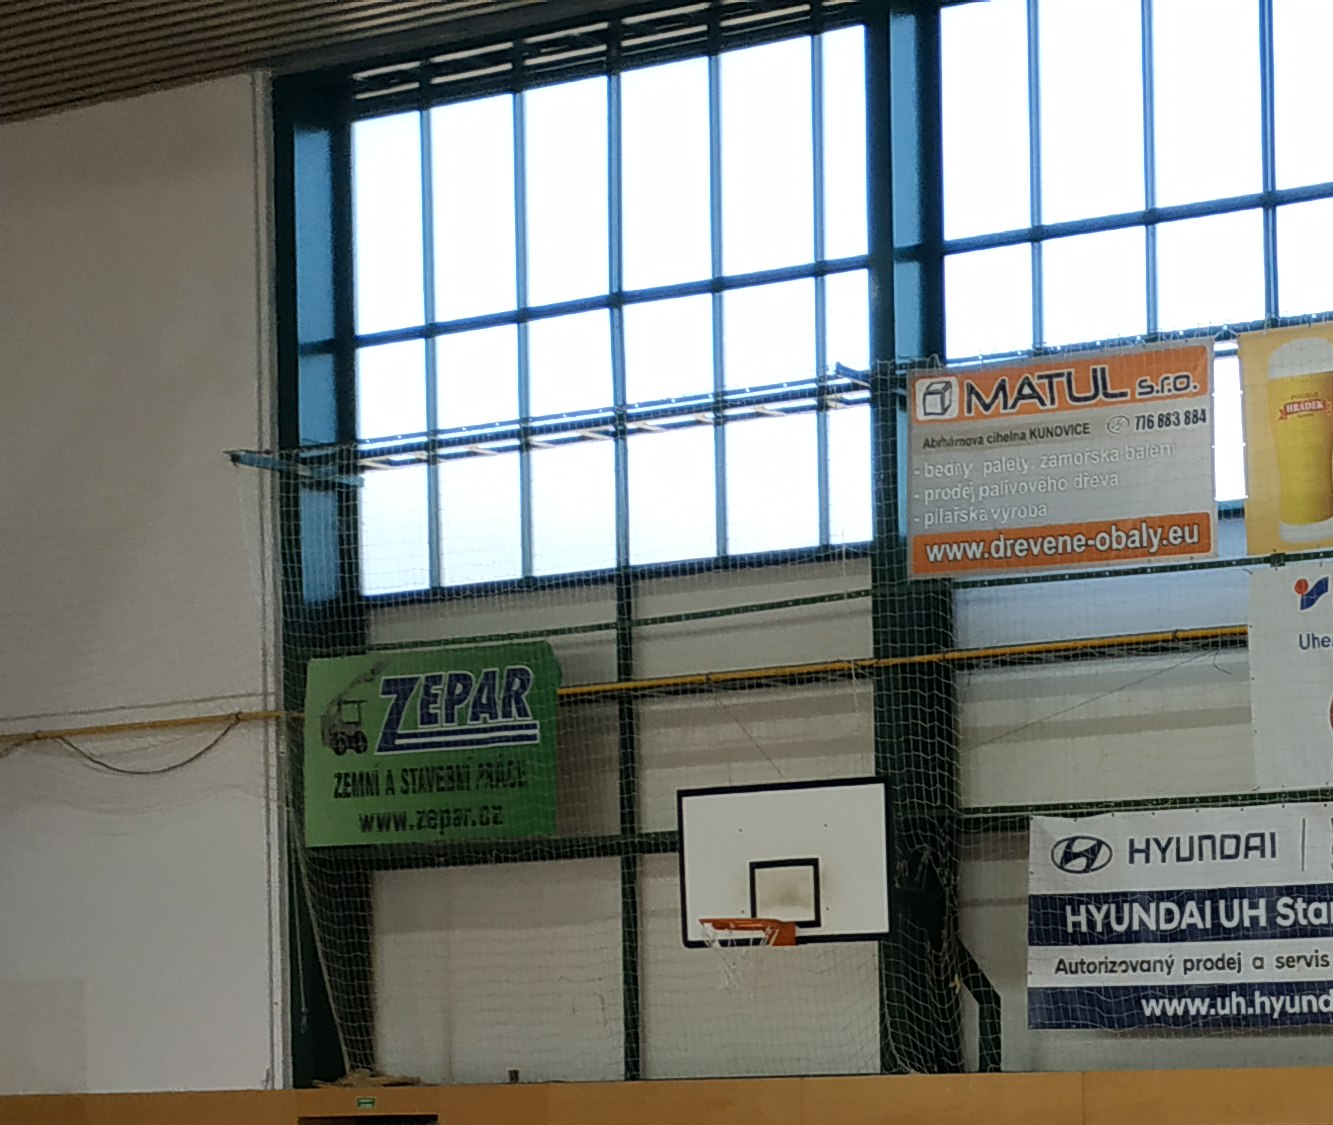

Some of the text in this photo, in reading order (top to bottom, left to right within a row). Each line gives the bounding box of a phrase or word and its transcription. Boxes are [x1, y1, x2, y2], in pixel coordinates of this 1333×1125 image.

[966, 366, 1199, 415] MATUL s.r.o.
[987, 429, 1026, 445] cihelna
[1029, 422, 1091, 440] KUNOVICE
[1134, 408, 1207, 431] 776 883 884
[924, 470, 1120, 505] prodej palivového dřeva
[924, 504, 1047, 529] pilařská výroba
[926, 521, 1200, 563] www.drevene-obaly.eu
[374, 666, 537, 755] ZEPAR
[334, 761, 380, 798] ZEMNÍ
[385, 769, 396, 796] A
[400, 756, 471, 795] STAVEBNÍ
[359, 804, 504, 836] www.zepar.cz
[1127, 831, 1277, 866] HYUNDAI
[1066, 898, 1212, 934] HYUNDAI
[1222, 896, 1268, 926] UH
[1054, 953, 1176, 977] Autorizovaný
[1183, 951, 1243, 976] prodej
[1252, 955, 1264, 970] a
[1275, 950, 1330, 971] servis
